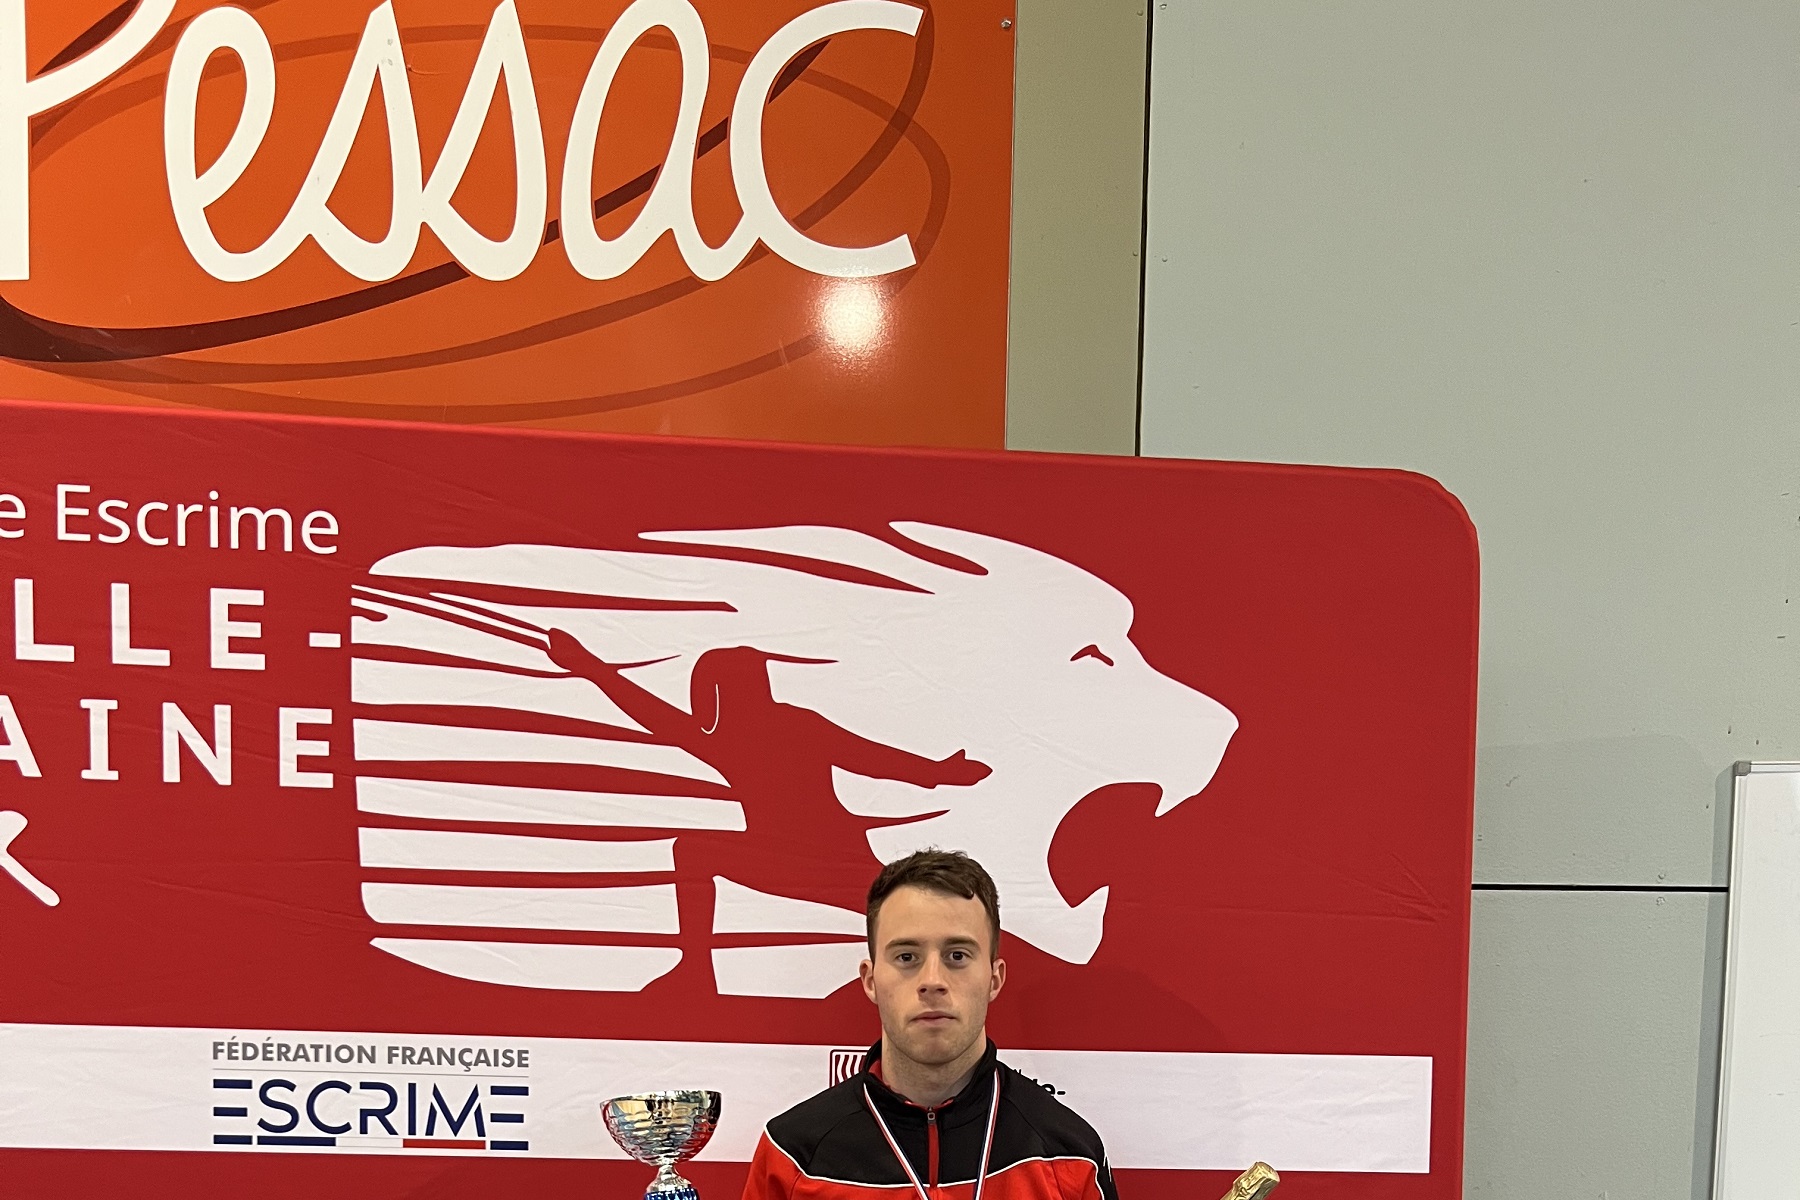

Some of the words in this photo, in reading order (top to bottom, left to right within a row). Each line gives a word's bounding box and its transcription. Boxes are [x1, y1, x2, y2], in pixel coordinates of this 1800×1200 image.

[56, 483, 339, 555] Escrime
[14, 578, 342, 671] LLE-
[0, 694, 334, 788] AINE
[212, 1036, 376, 1064] FÉDÉRATION
[387, 1046, 530, 1072] FRANÇAISE
[213, 1078, 529, 1151] ESCRIME
